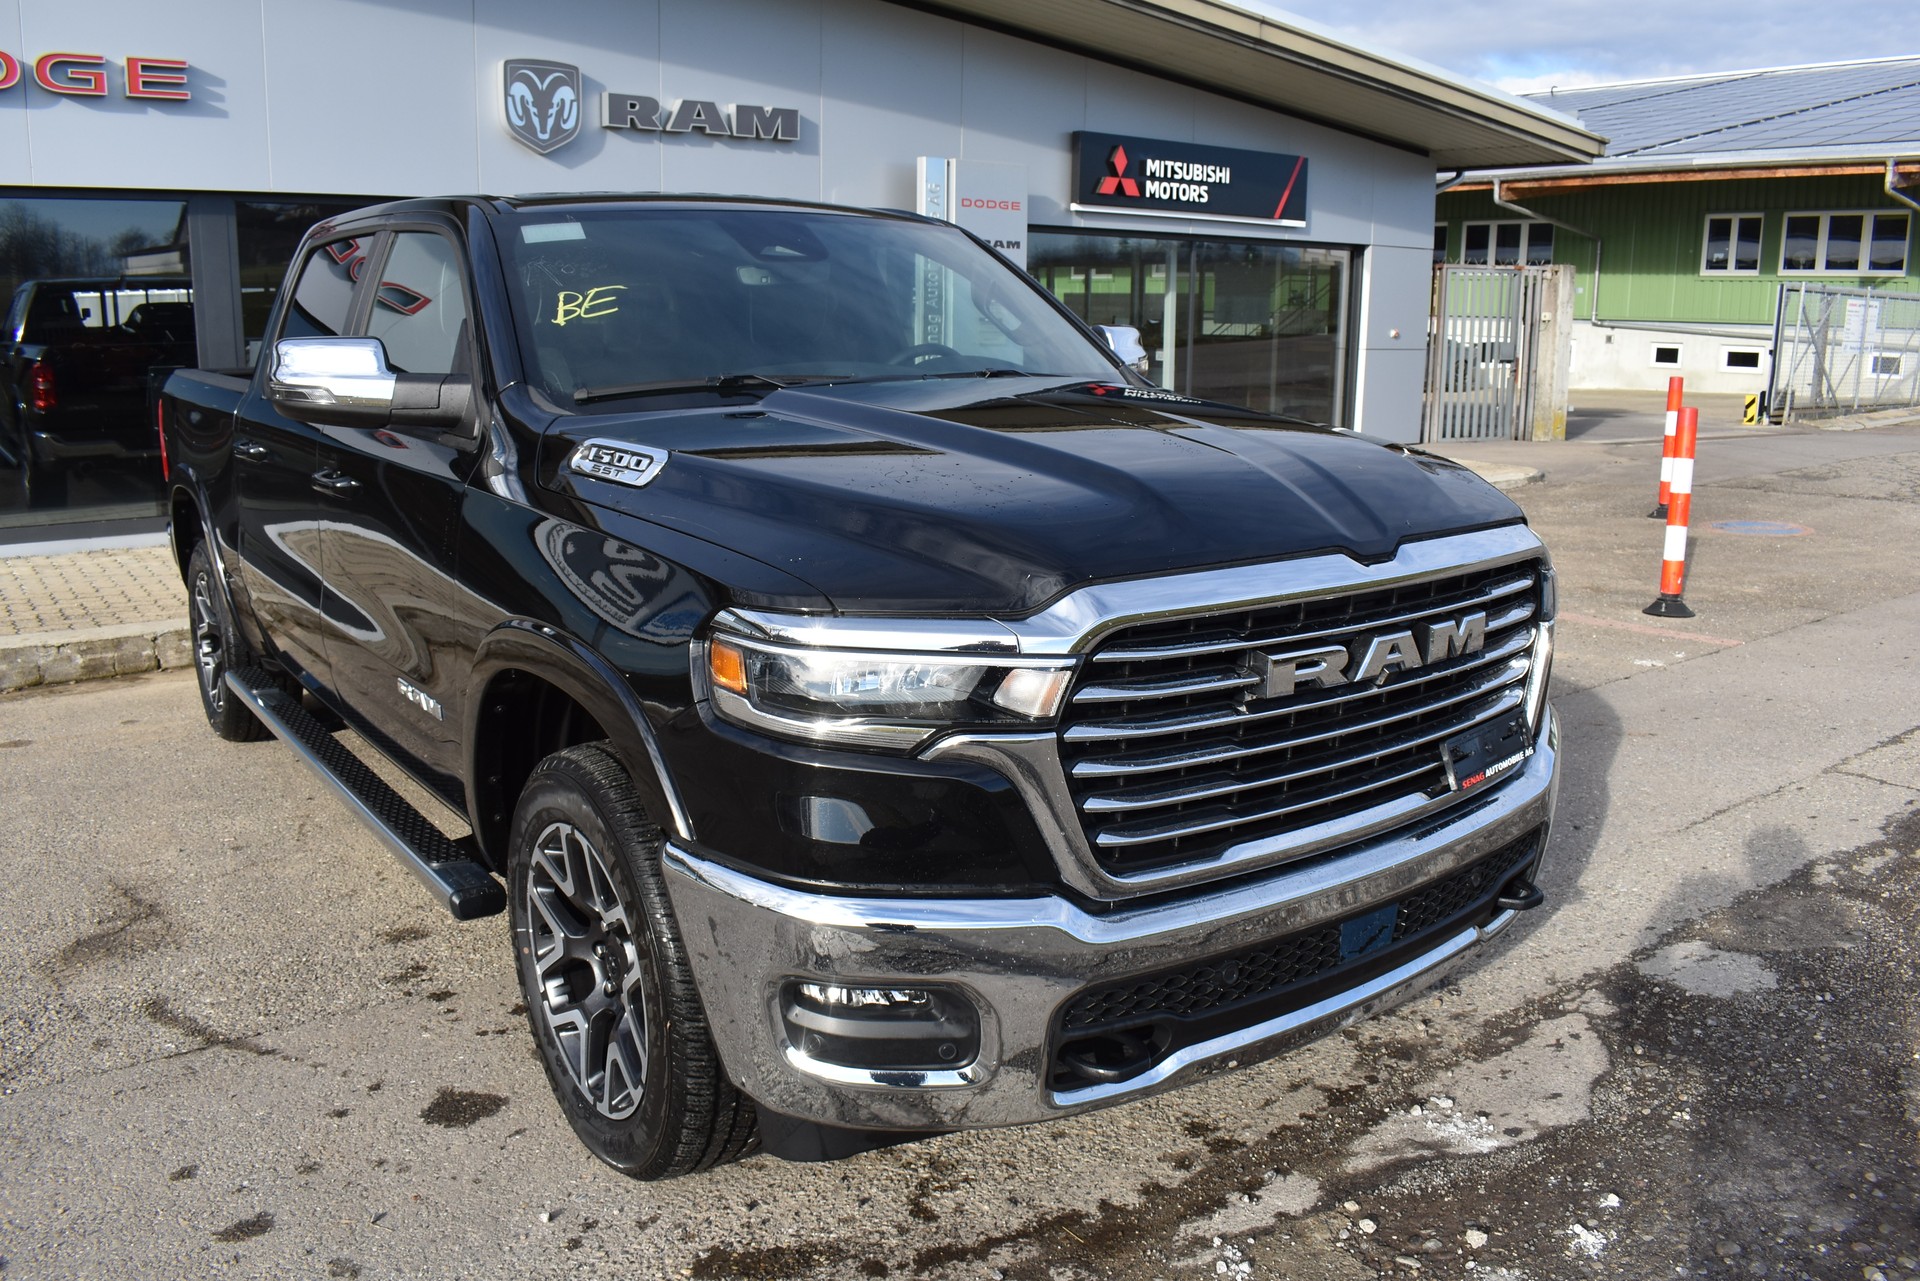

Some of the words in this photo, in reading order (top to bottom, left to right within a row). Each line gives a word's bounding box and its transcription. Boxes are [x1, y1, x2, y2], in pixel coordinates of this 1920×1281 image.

[602, 91, 801, 141] RAM
[1146, 158, 1230, 184] MITSUBISHI
[928, 183, 941, 206] AG
[961, 198, 1021, 210] DODGE
[1145, 180, 1209, 203] MOTORS
[551, 285, 628, 326] BE
[588, 446, 651, 471] 1500
[591, 463, 627, 477] SST
[1260, 611, 1487, 699] RAM
[1462, 771, 1485, 789] SENAG
[1485, 751, 1525, 778] AUTOMOBILE
[1525, 746, 1534, 758] AG
